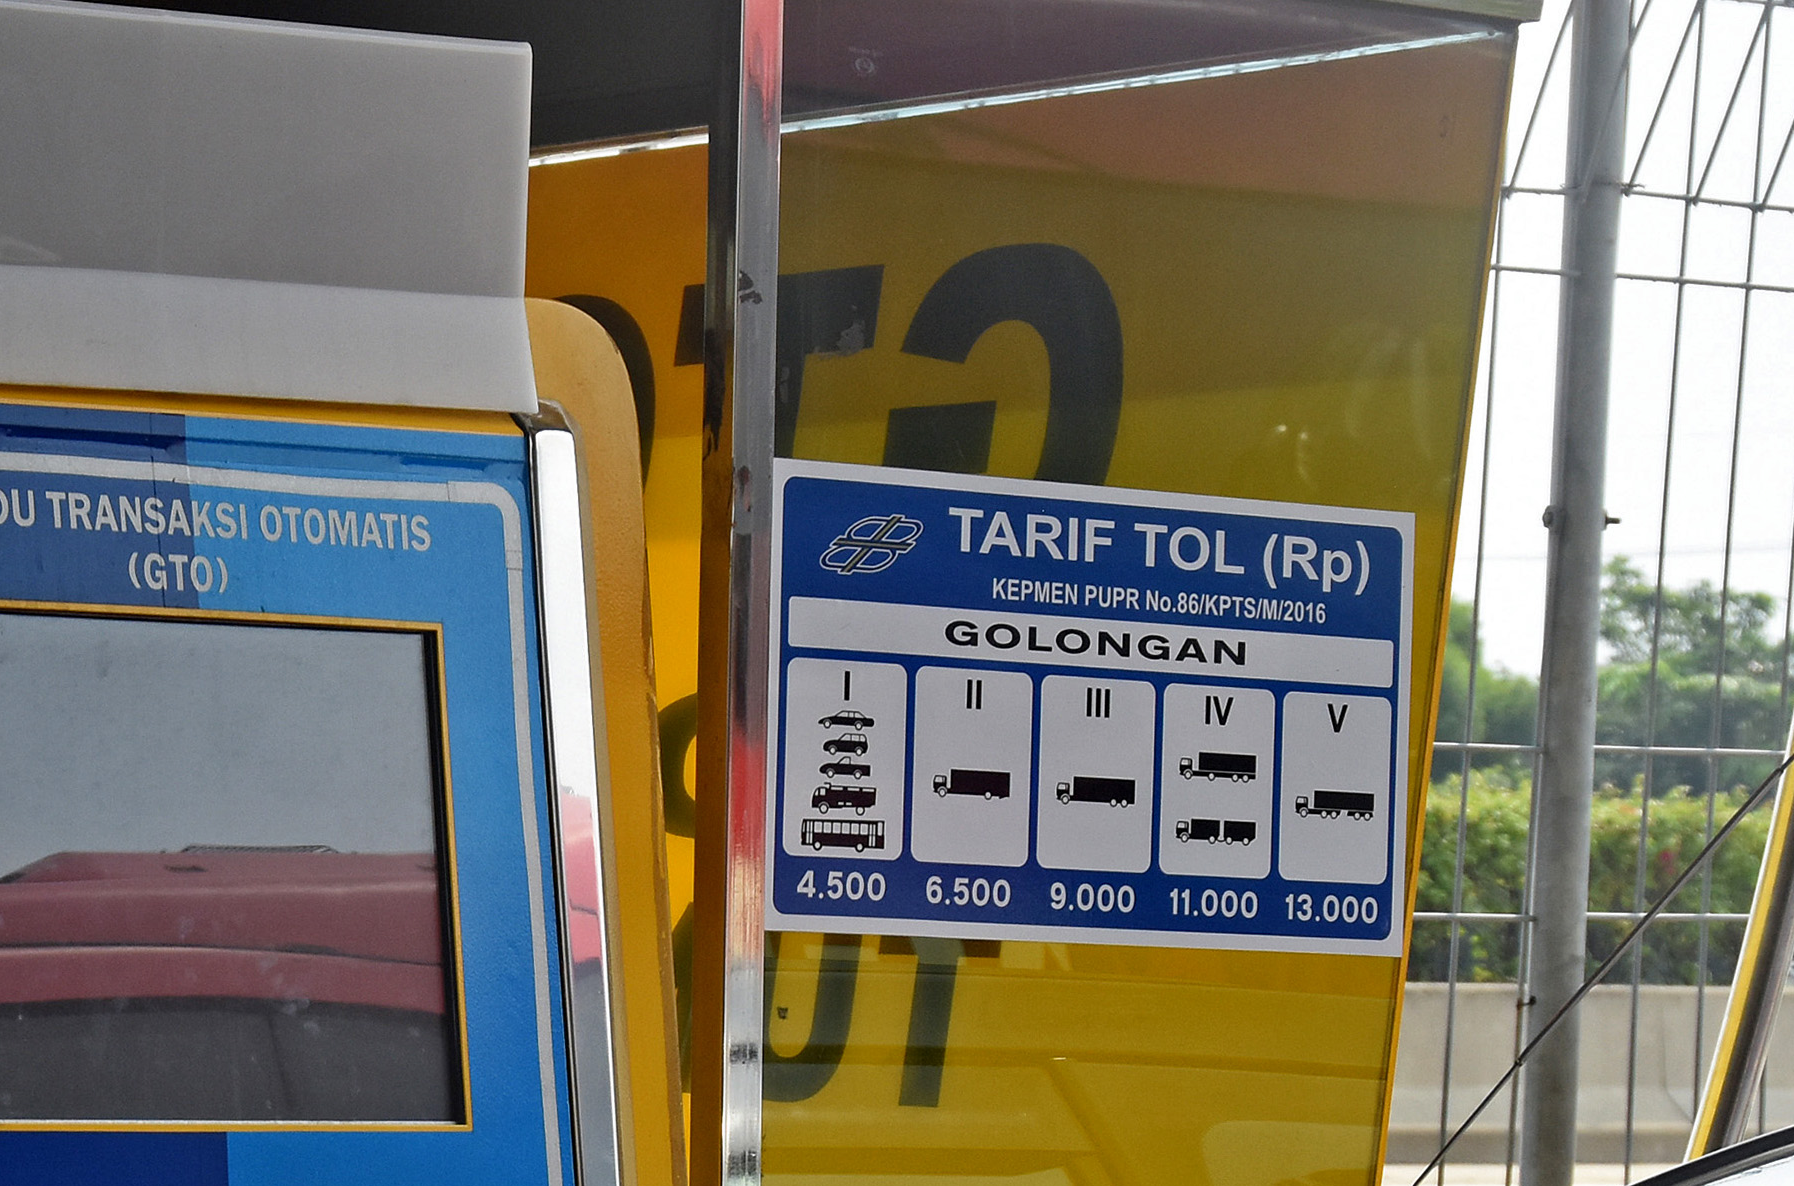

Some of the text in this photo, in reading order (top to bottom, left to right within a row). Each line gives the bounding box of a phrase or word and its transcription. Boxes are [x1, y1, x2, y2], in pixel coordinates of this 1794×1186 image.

[46, 490, 248, 540] TRANSAKSI
[260, 504, 431, 552] OTOMATIS
[127, 552, 229, 594] (GTO)
[948, 506, 1370, 596] TARIF TOL (Rp)
[993, 577, 1327, 625] KEPMEN PUPR No.86/KPTS/M/2016
[944, 619, 1247, 666] GOLONGAN
[843, 670, 1349, 734] I II III IV V
[796, 870, 1379, 925] 4.500 6.500 9.000 11.000 13.000
